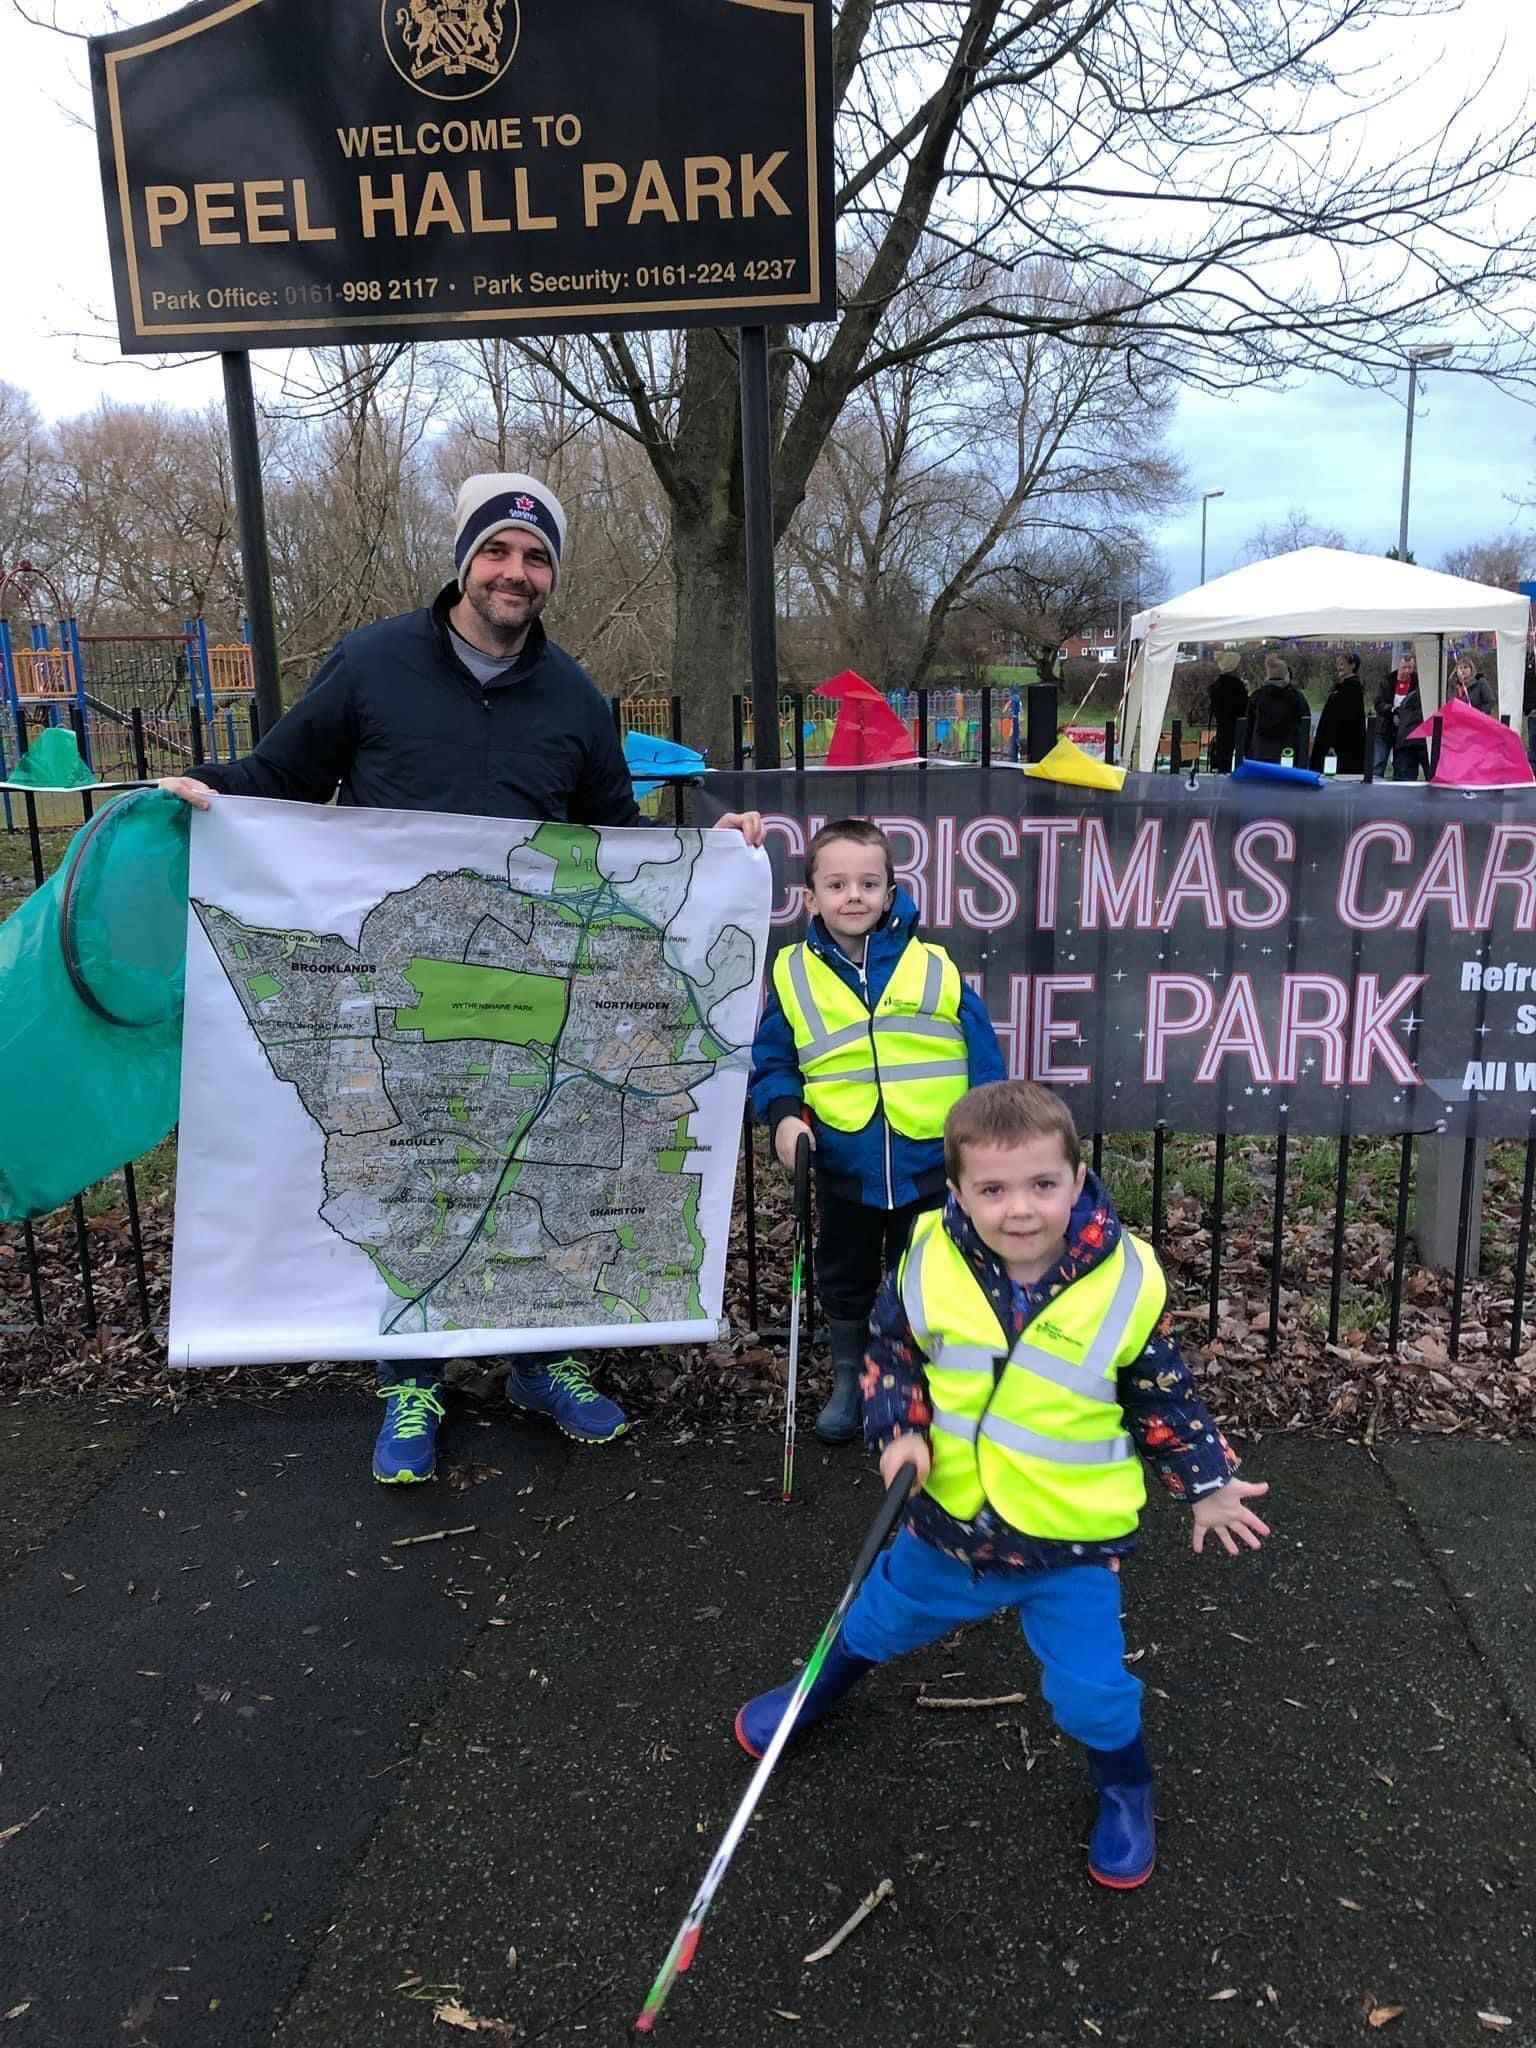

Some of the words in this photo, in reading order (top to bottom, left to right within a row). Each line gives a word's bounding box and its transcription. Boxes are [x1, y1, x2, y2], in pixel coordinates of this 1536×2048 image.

[337, 118, 522, 158] WELCOME
[534, 113, 582, 147] TO
[145, 179, 337, 248] PEEL
[359, 167, 558, 238] HALL
[583, 150, 793, 227] PARK
[473, 274, 523, 295] Park
[529, 268, 629, 294] Security:
[636, 263, 737, 287] 0161-224
[743, 258, 797, 281] 4237
[152, 289, 200, 311] Park
[207, 287, 278, 309] Office:
[285, 280, 382, 304] 0161-998
[388, 277, 439, 300] 2117
[760, 813, 1297, 931] CRISTMAS
[291, 962, 377, 974] BROOKLANDS
[1461, 961, 1536, 993] Refr
[595, 1001, 670, 1011] NORTHENDEN
[961, 972, 1096, 1084] HE
[1143, 973, 1431, 1086] PARK
[1462, 1061, 1507, 1091] All
[389, 1138, 445, 1147] BAGULEY
[590, 1206, 647, 1217] SHARSTON
